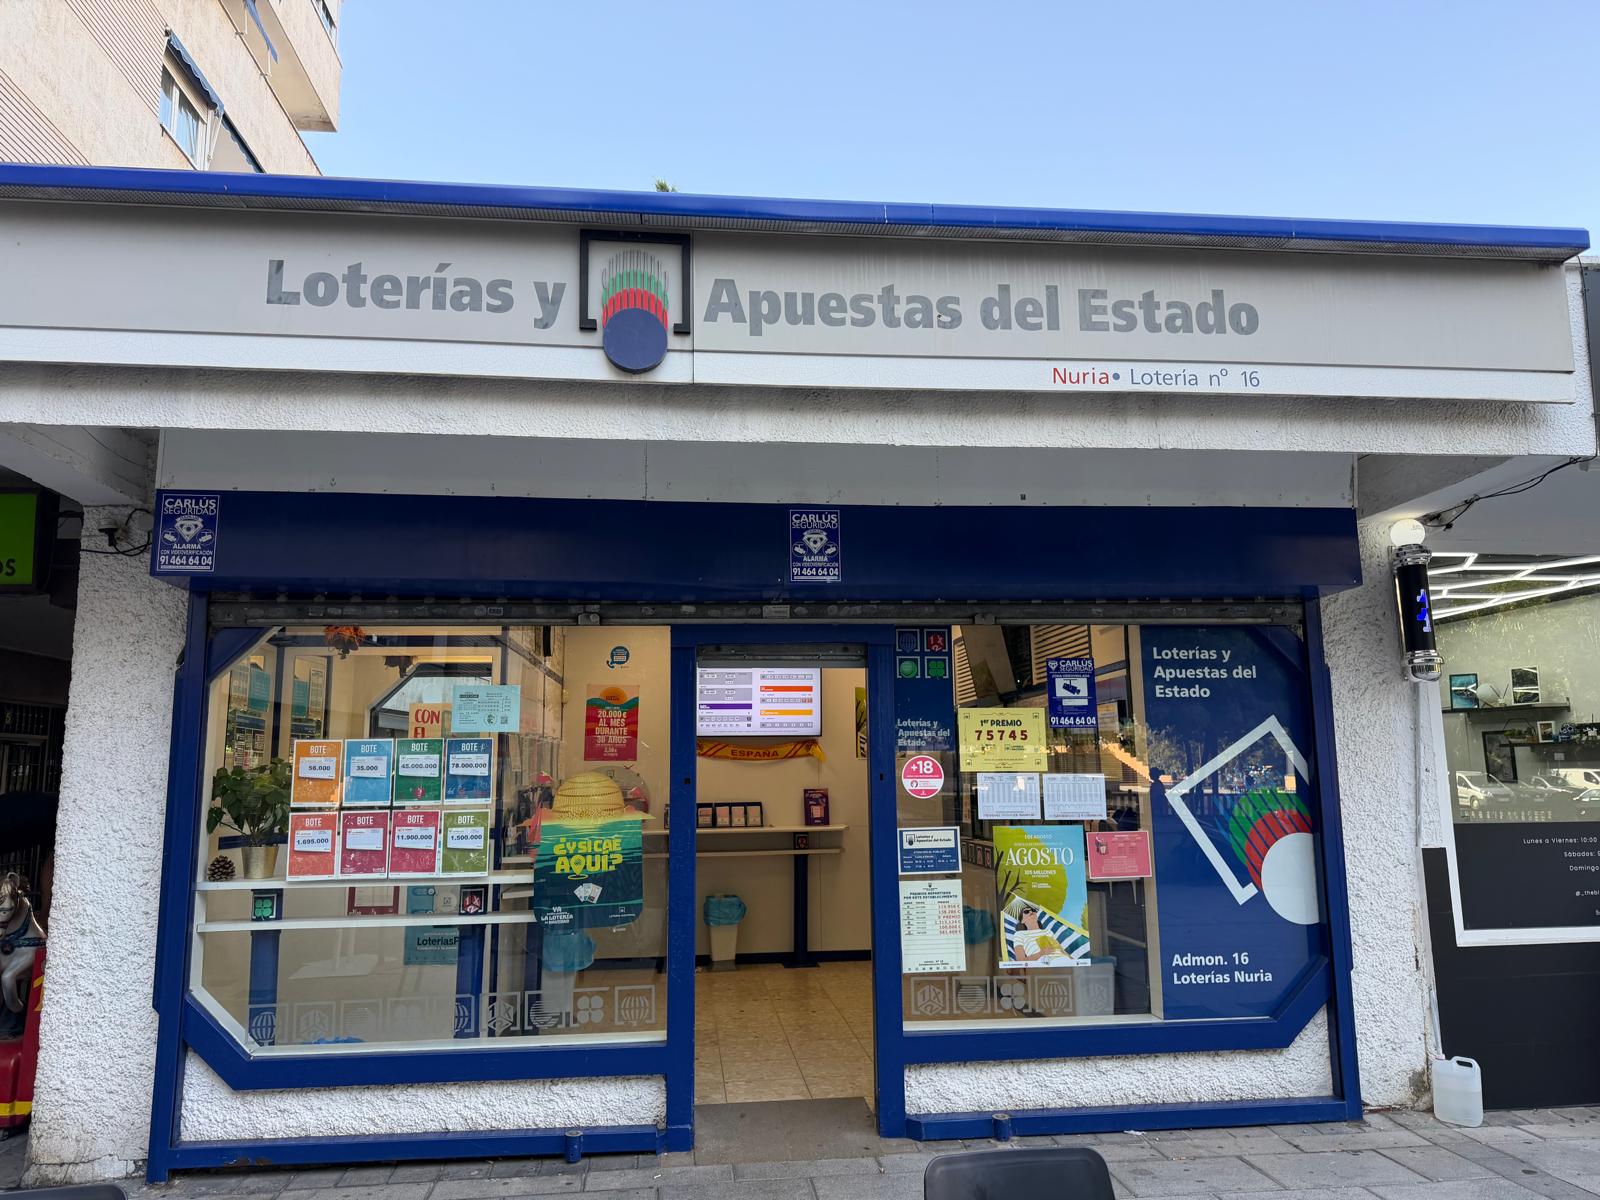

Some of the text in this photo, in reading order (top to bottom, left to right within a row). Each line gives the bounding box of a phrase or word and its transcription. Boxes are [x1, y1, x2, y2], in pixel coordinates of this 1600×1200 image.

[266, 260, 1259, 336] Loterías y Apuestas del Estado
[1131, 369, 1198, 387] Lotería
[1210, 369, 1228, 387] nº
[1241, 371, 1260, 388] 16
[165, 497, 216, 509] CARLÚS
[164, 507, 216, 515] SEGURIDAD
[792, 512, 837, 522] CARLÚS
[792, 521, 838, 529] SEGURIDAD
[160, 556, 212, 565] 91 464 64 04
[1153, 646, 1231, 662] Loterías y
[1060, 659, 1092, 667] CARLÚS
[1154, 665, 1257, 681] Apuestas del
[1155, 684, 1210, 697] Estado
[415, 709, 440, 724] CON
[1051, 716, 1096, 725] 91 464 64 04
[897, 719, 938, 728] Loterías y
[991, 719, 1022, 727] PREMIO
[595, 727, 627, 735] DURANTE
[898, 729, 950, 738] Apuestas del
[898, 738, 926, 746] Estado
[310, 746, 327, 754] BOTE
[361, 745, 378, 753] BOTE
[411, 743, 428, 751] BOTE
[461, 743, 478, 751] BOTE
[731, 749, 779, 758] ESPAÑA
[911, 761, 933, 774] +18
[305, 818, 322, 826] BOTE
[357, 816, 374, 825] BOTE
[407, 815, 424, 824] BOTE
[458, 816, 475, 824] BOTE
[1005, 847, 1074, 866] AGOSTO
[1172, 952, 1249, 967] Admon. 16
[1173, 969, 1272, 984] Loterías Nuria
